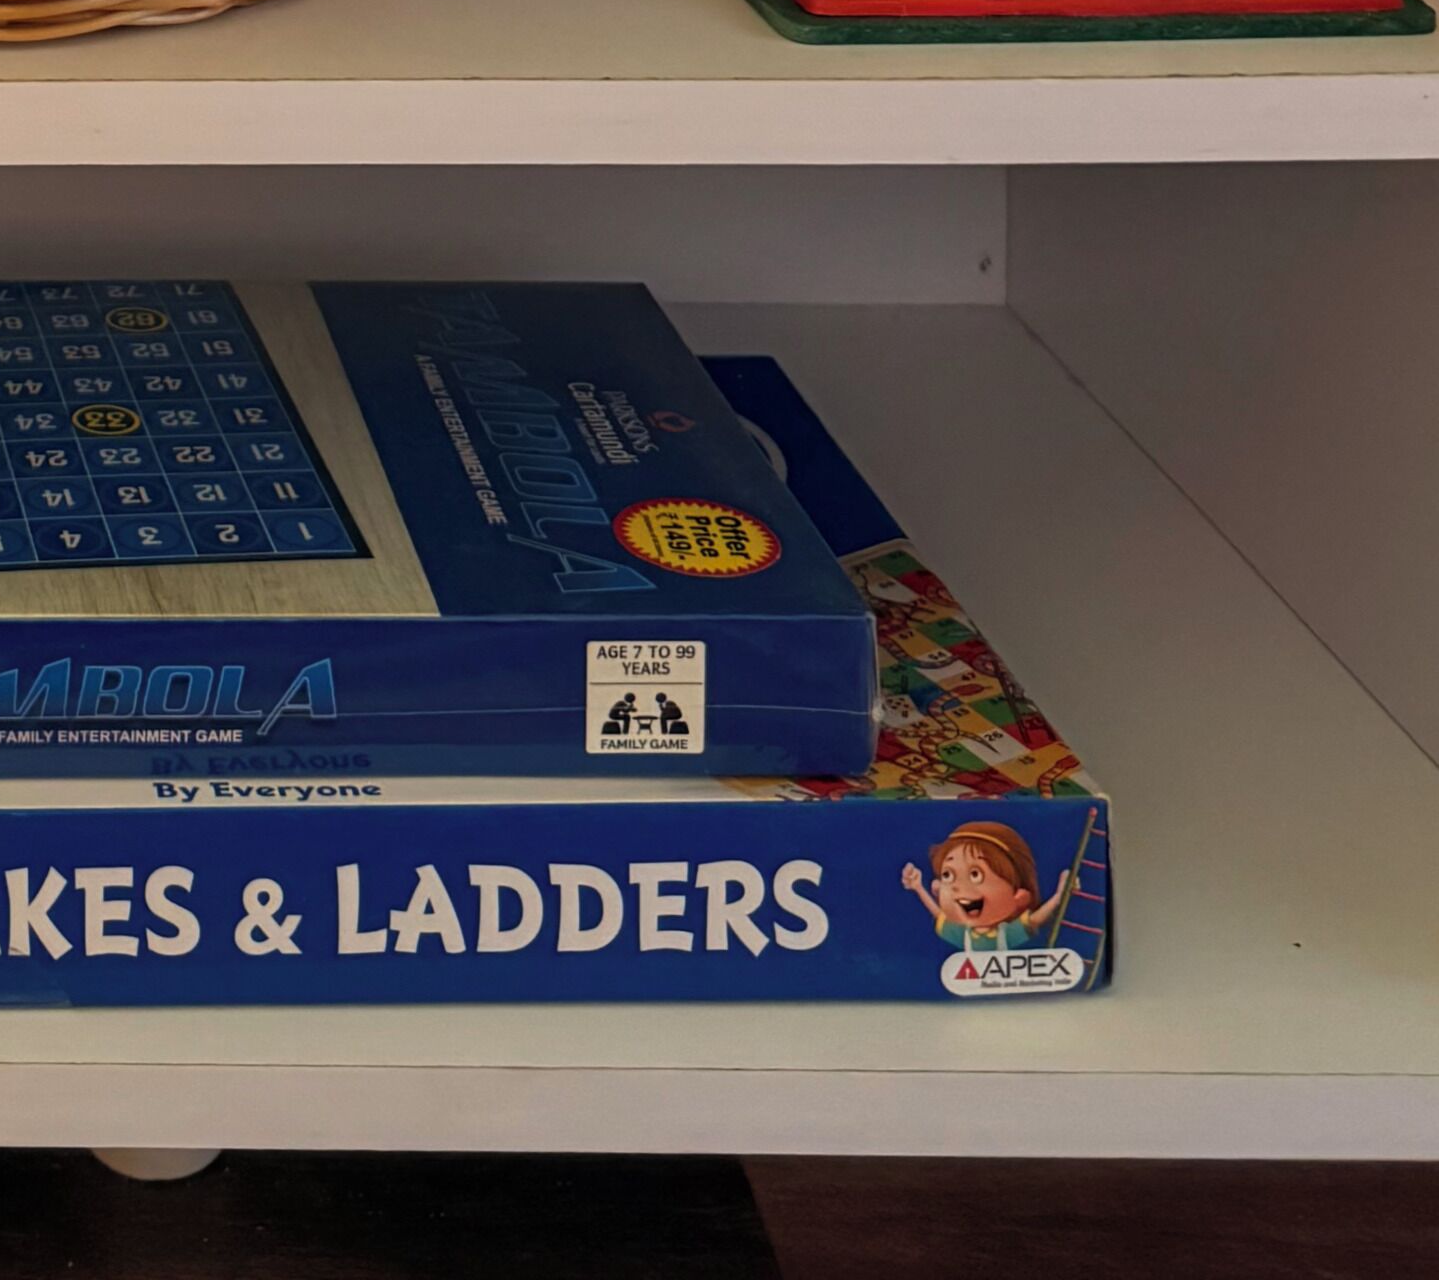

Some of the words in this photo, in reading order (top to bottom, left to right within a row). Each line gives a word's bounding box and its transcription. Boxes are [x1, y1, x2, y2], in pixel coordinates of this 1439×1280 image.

[51, 314, 90, 329] 63
[118, 311, 158, 327] 62
[187, 310, 219, 325] 61
[61, 344, 102, 361] 53
[130, 342, 171, 358] 52
[202, 340, 234, 356] 51
[4, 379, 43, 396] 44
[73, 377, 113, 394] 43
[143, 375, 182, 392] 42
[217, 373, 248, 390] 41
[14, 413, 57, 431] 34
[83, 411, 129, 429] 33
[157, 409, 201, 427] 32
[233, 407, 268, 425] 31
[568, 382, 640, 464] Cartamundi
[25, 449, 68, 468] 24
[98, 447, 142, 466] 23
[172, 445, 216, 463] 22
[250, 443, 285, 461] 21
[41, 488, 75, 507] 14
[117, 486, 151, 505] 13
[193, 484, 227, 502] 12
[273, 481, 299, 500] 11
[475, 489, 509, 525] GAME
[59, 530, 81, 549] 4
[137, 526, 163, 546] 3
[215, 524, 240, 543] 2
[298, 522, 313, 541] 1
[685, 515, 719, 558] Price
[715, 516, 750, 560] Offer
[597, 645, 628, 659] AGE
[633, 645, 642, 659] 7
[648, 645, 671, 659] TO
[675, 645, 696, 659] 99
[622, 662, 671, 675] YEARS
[57, 729, 192, 744] ENTERTAINMENT
[195, 728, 244, 743] GAME
[600, 738, 647, 750] FAMILY
[650, 738, 689, 750] GAME
[152, 781, 200, 802] By
[209, 781, 383, 802] Everyone
[234, 878, 302, 956] &
[336, 860, 830, 957] LADDERS
[981, 952, 1071, 979] APEX
